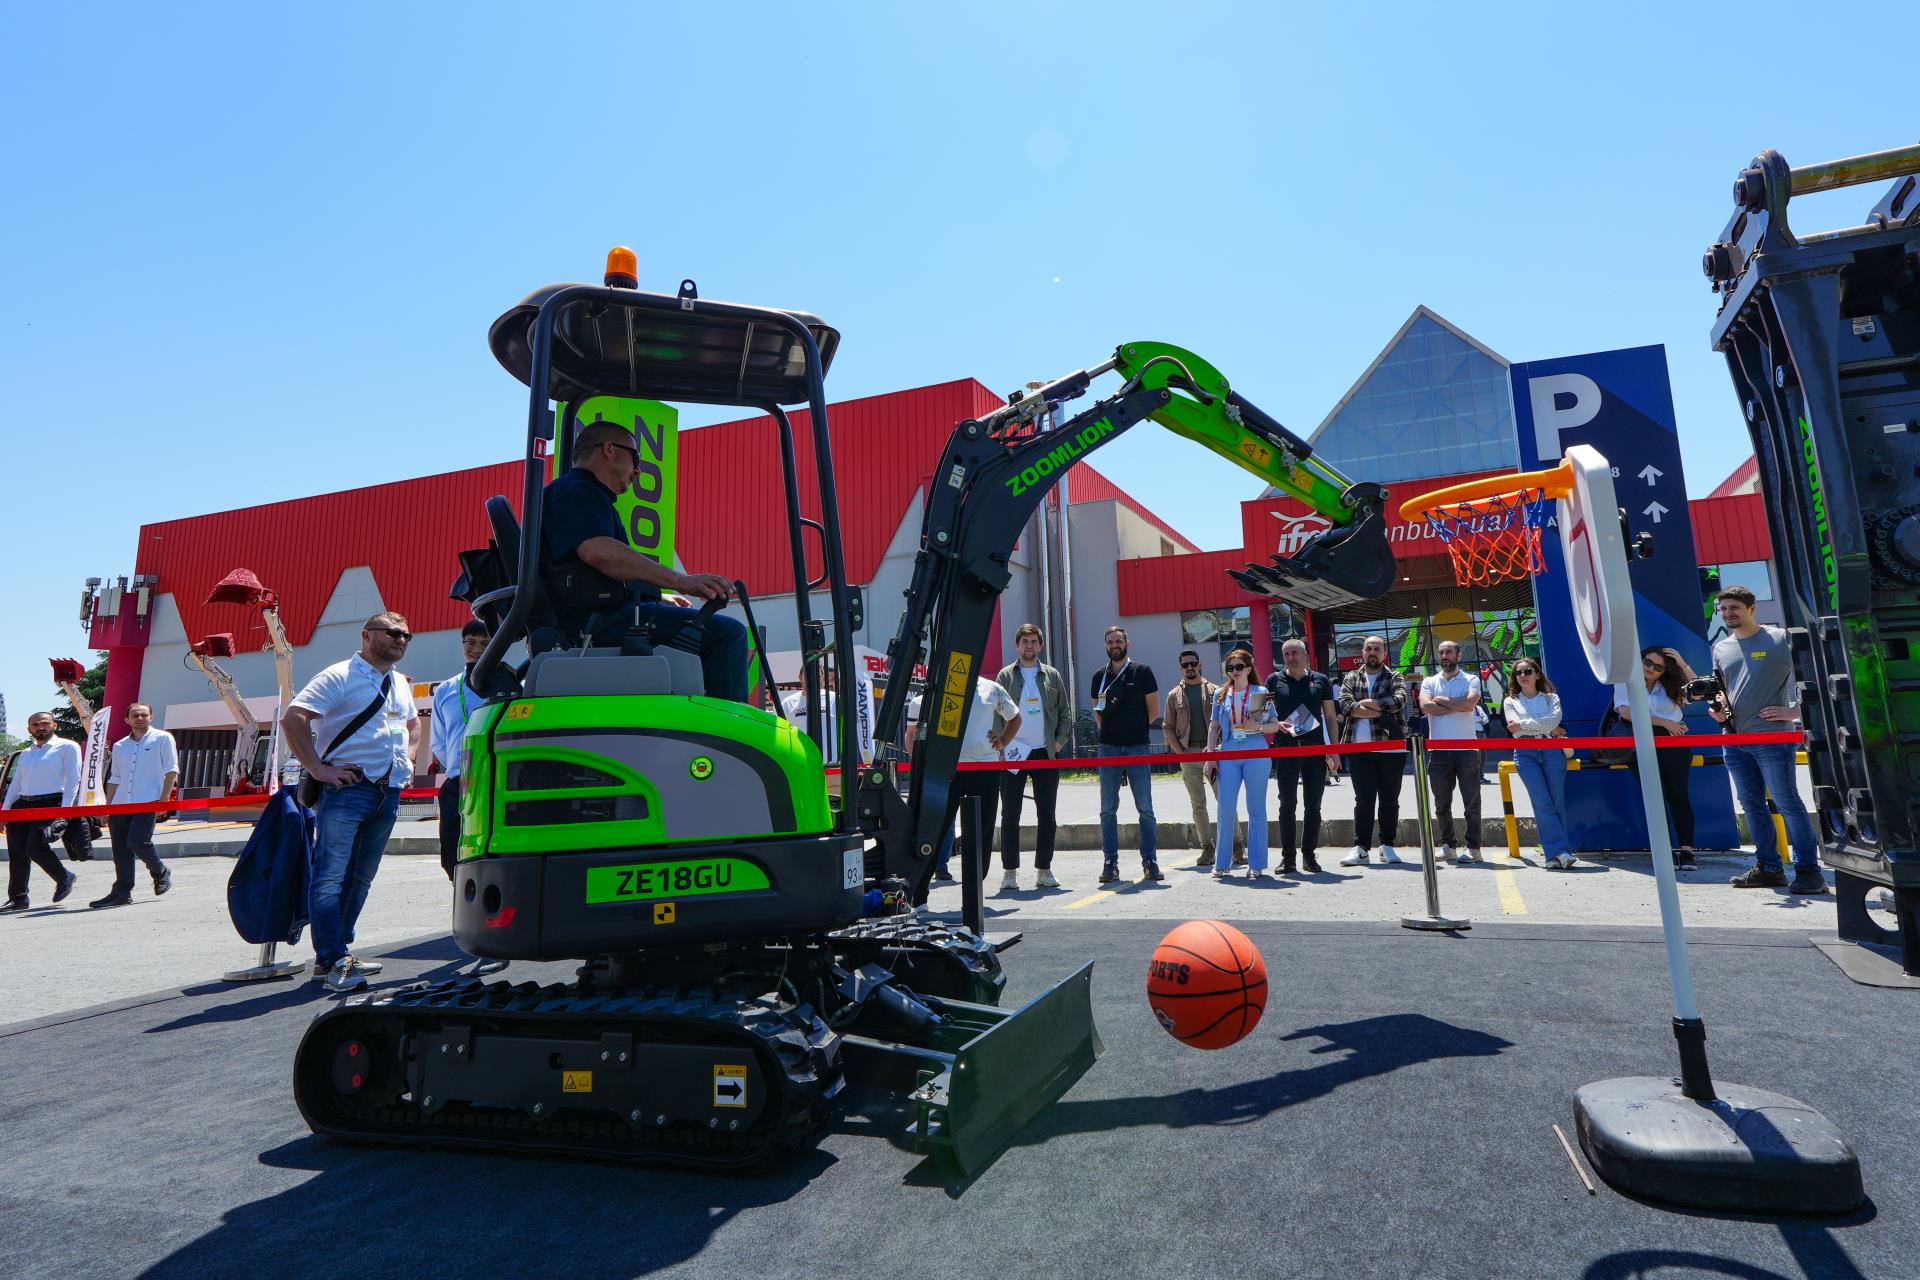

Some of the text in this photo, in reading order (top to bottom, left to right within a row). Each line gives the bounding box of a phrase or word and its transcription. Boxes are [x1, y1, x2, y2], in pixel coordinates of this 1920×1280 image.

[1529, 373, 1602, 461] P
[1005, 416, 1115, 497] ZOOMLION
[1799, 416, 1837, 610] ZOOMLION
[87, 721, 102, 790] CERMAK
[615, 863, 732, 896] ZE18GU
[847, 867, 858, 886] 93
